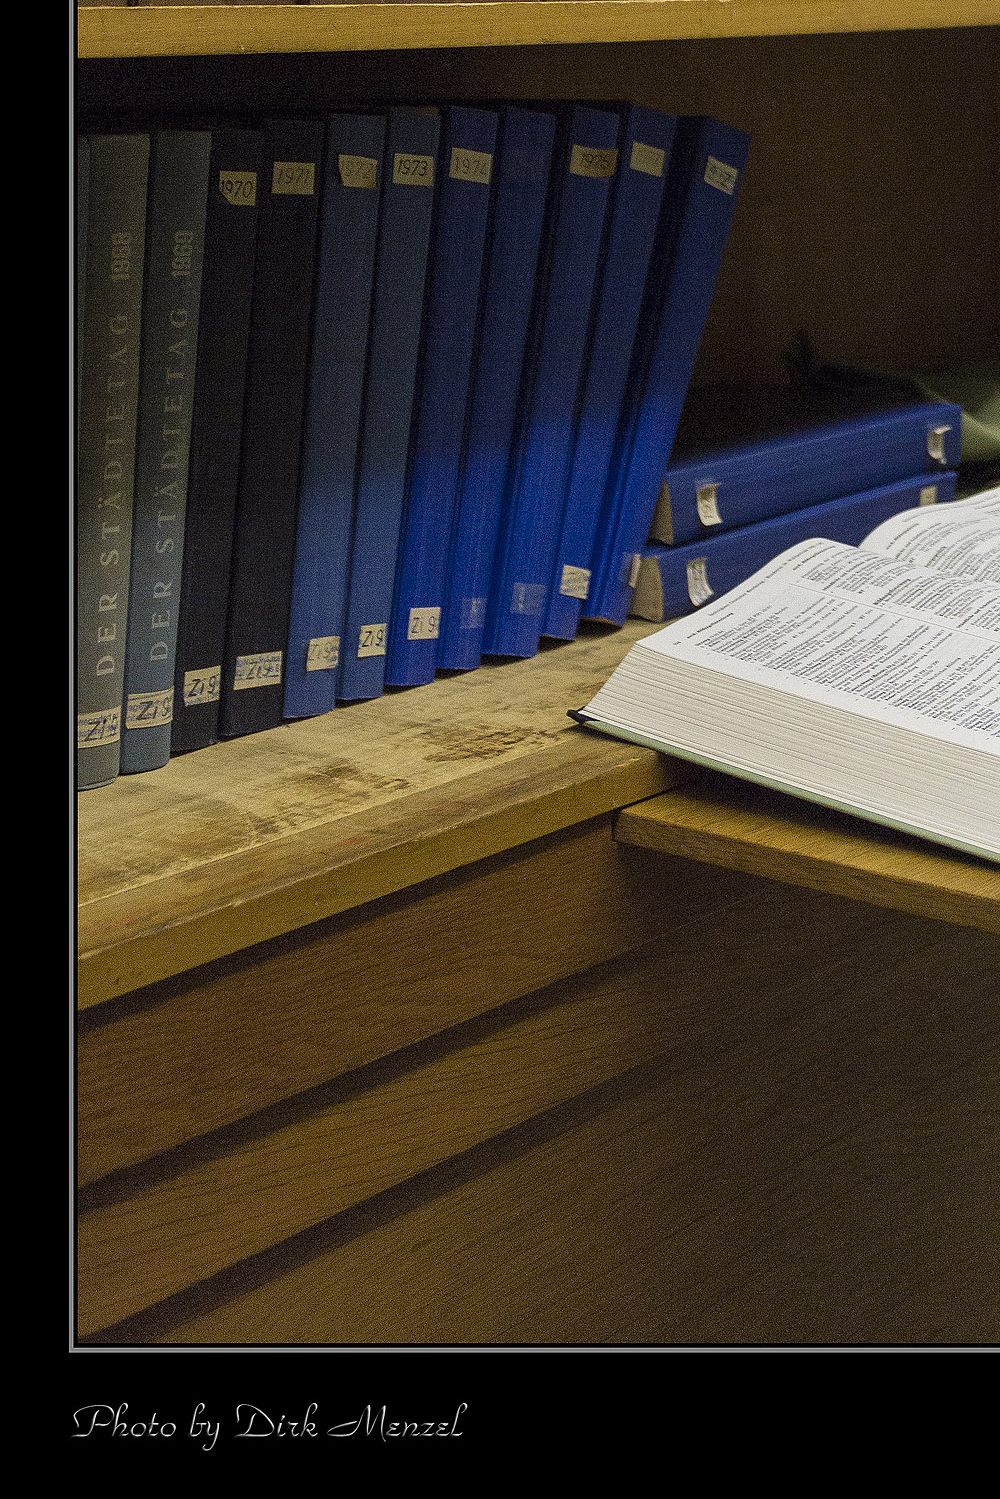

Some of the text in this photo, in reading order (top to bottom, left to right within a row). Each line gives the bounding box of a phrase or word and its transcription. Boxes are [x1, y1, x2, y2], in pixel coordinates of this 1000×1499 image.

[221, 180, 254, 199] 1970
[397, 159, 429, 177] 1973
[97, 314, 129, 567] STÄDTETAG
[153, 307, 189, 554] STÄDTETAG
[96, 591, 119, 677] DER
[149, 579, 174, 662] DER
